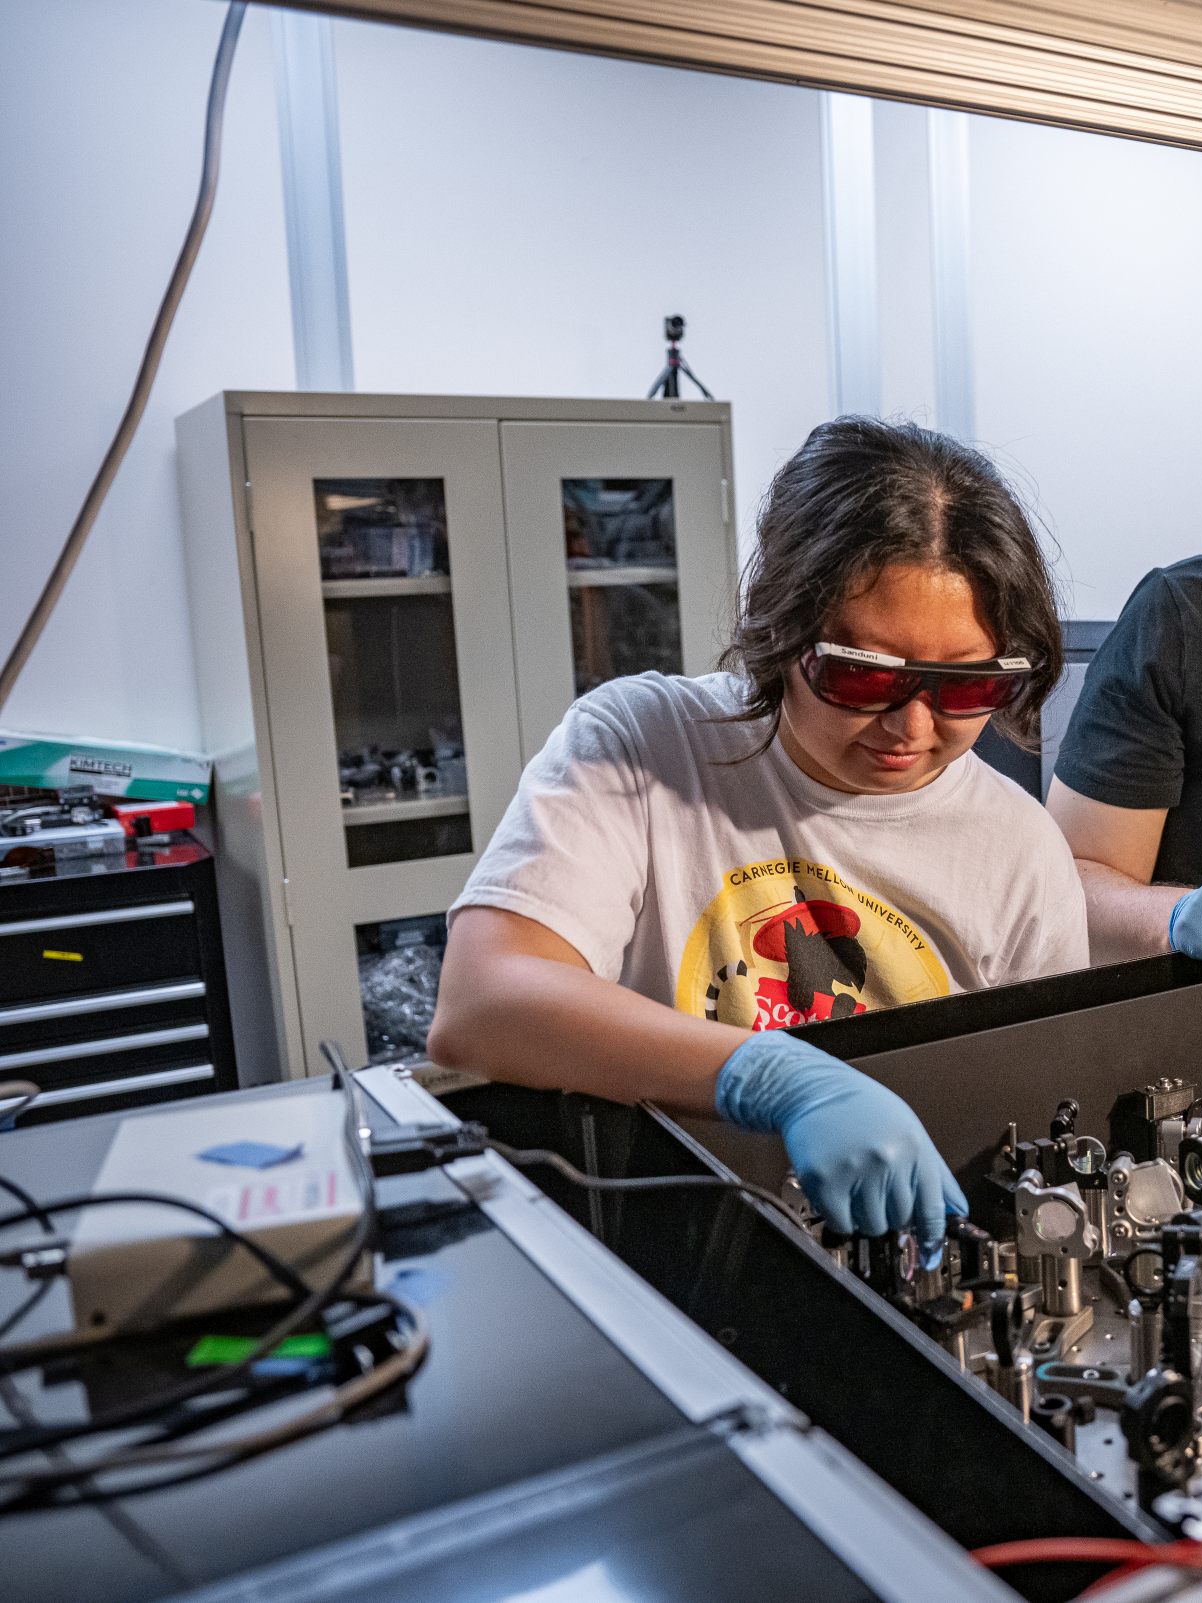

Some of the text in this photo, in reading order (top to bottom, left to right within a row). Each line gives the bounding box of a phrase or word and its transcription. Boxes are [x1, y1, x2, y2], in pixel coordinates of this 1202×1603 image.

[841, 648, 879, 661] Sanduni
[70, 758, 132, 774] KIMTECH
[730, 861, 801, 886] CARNEGIE
[857, 893, 925, 951] UNIVERSITY
